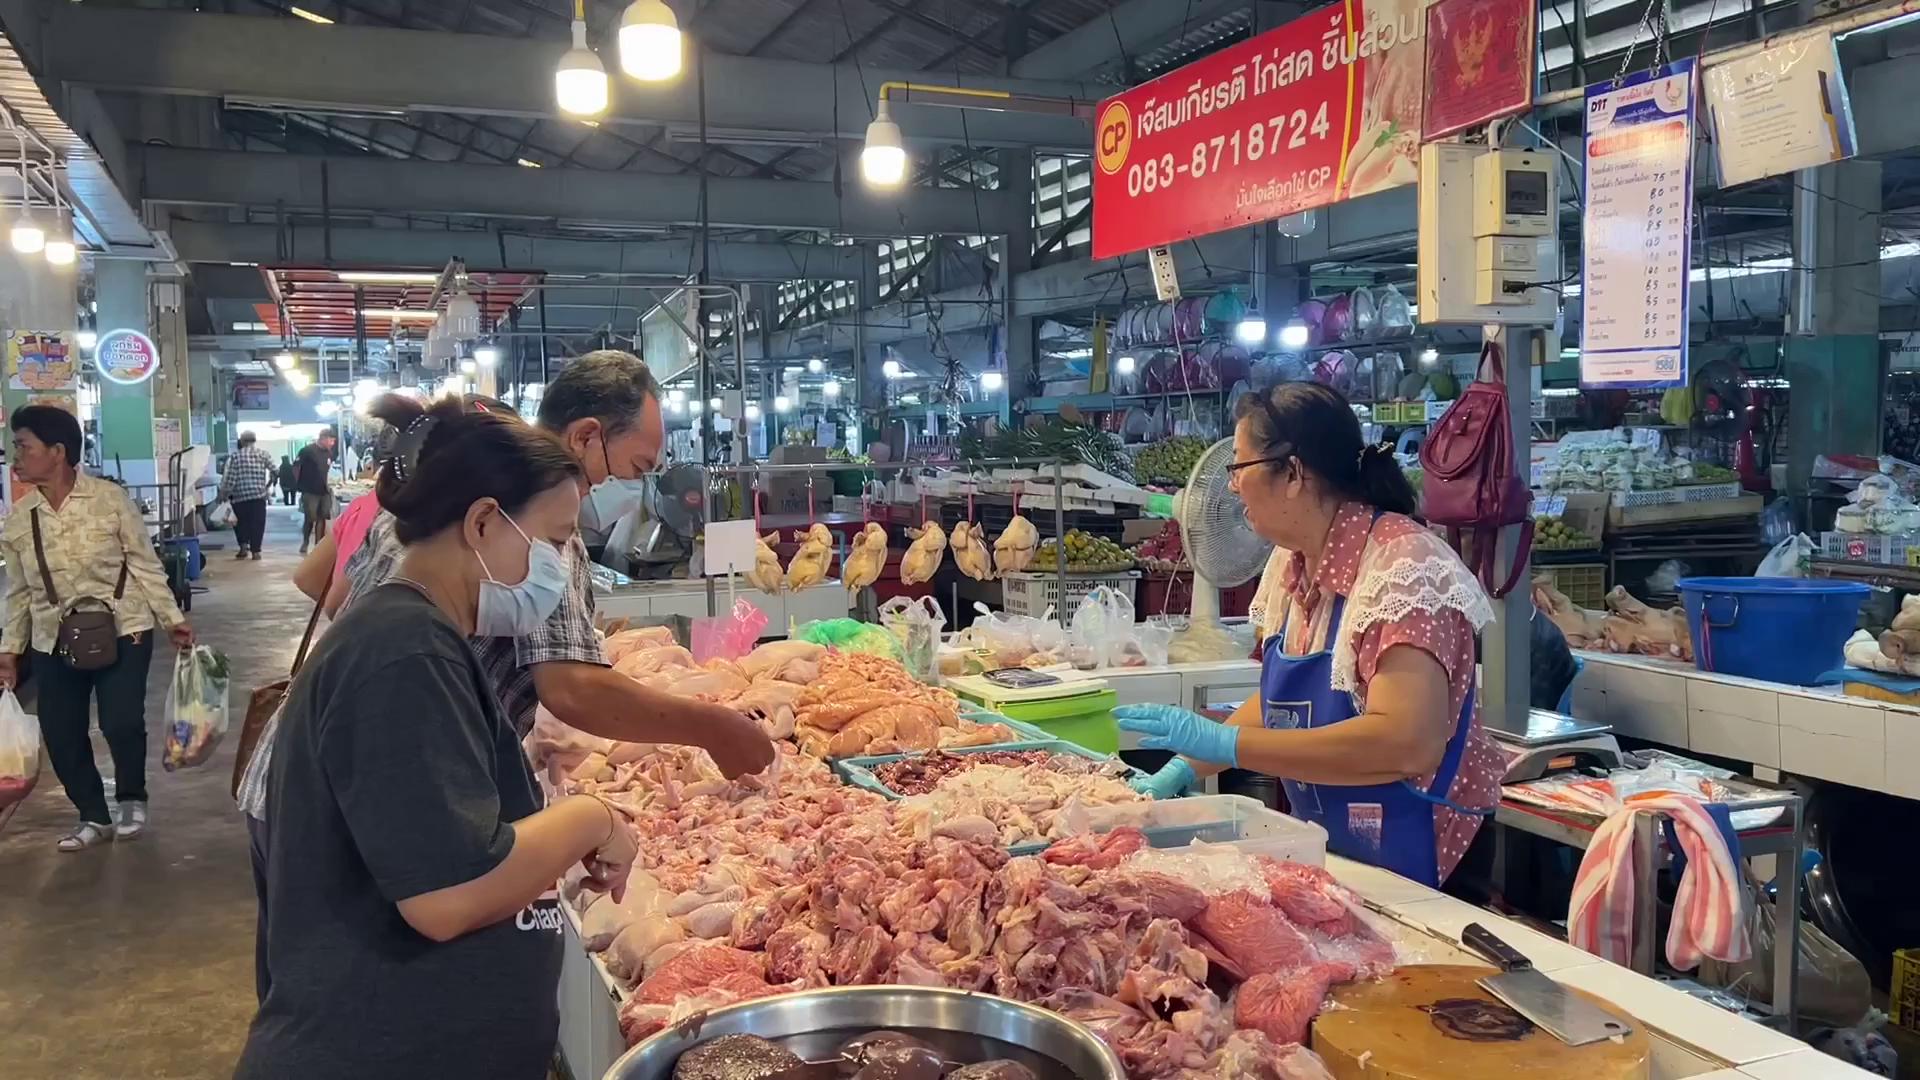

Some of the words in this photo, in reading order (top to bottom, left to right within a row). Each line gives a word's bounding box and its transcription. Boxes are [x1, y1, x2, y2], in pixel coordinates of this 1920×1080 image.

[1137, 64, 1247, 138] เจ๊สมเกียรติ
[1252, 48, 1313, 96] ไก่สด
[1101, 121, 1127, 157] CP
[1127, 101, 1330, 198] 083-8718724
[1235, 170, 1306, 209] มั่นใจเลือกใช้
[1308, 165, 1331, 190] CP
